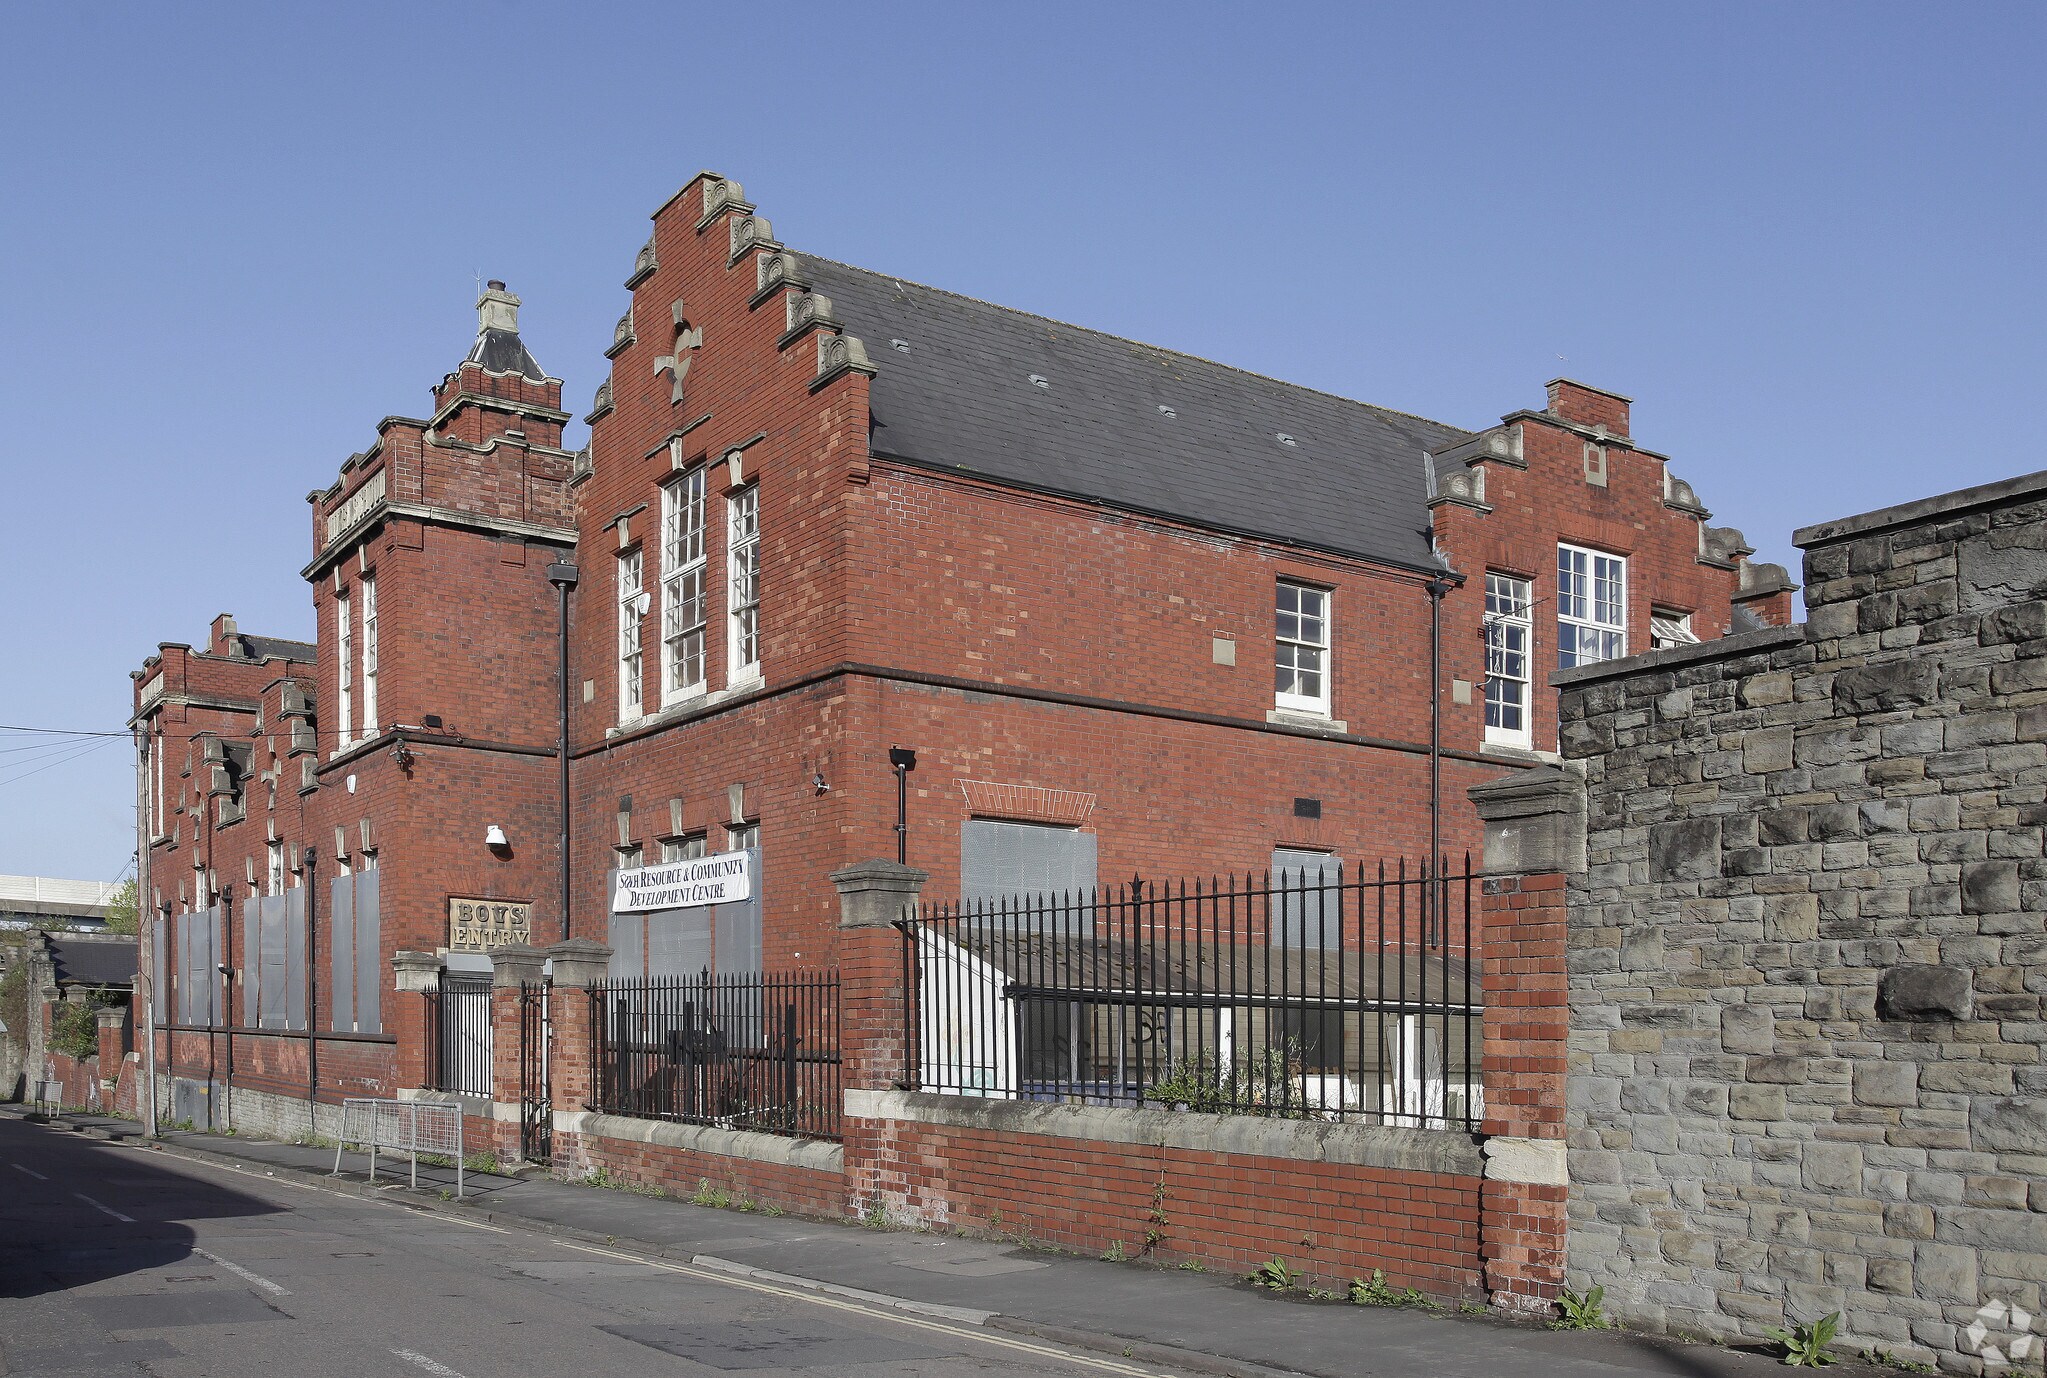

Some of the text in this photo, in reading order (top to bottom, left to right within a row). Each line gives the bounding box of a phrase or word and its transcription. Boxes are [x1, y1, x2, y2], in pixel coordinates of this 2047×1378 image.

[640, 867, 681, 888] RESOURCE
[683, 867, 689, 881] &
[691, 859, 744, 881] COMMUNITY
[630, 883, 725, 907] DEVELOPMENT CENTRE
[458, 903, 524, 924] BOYS
[454, 926, 529, 947] ENTRY
